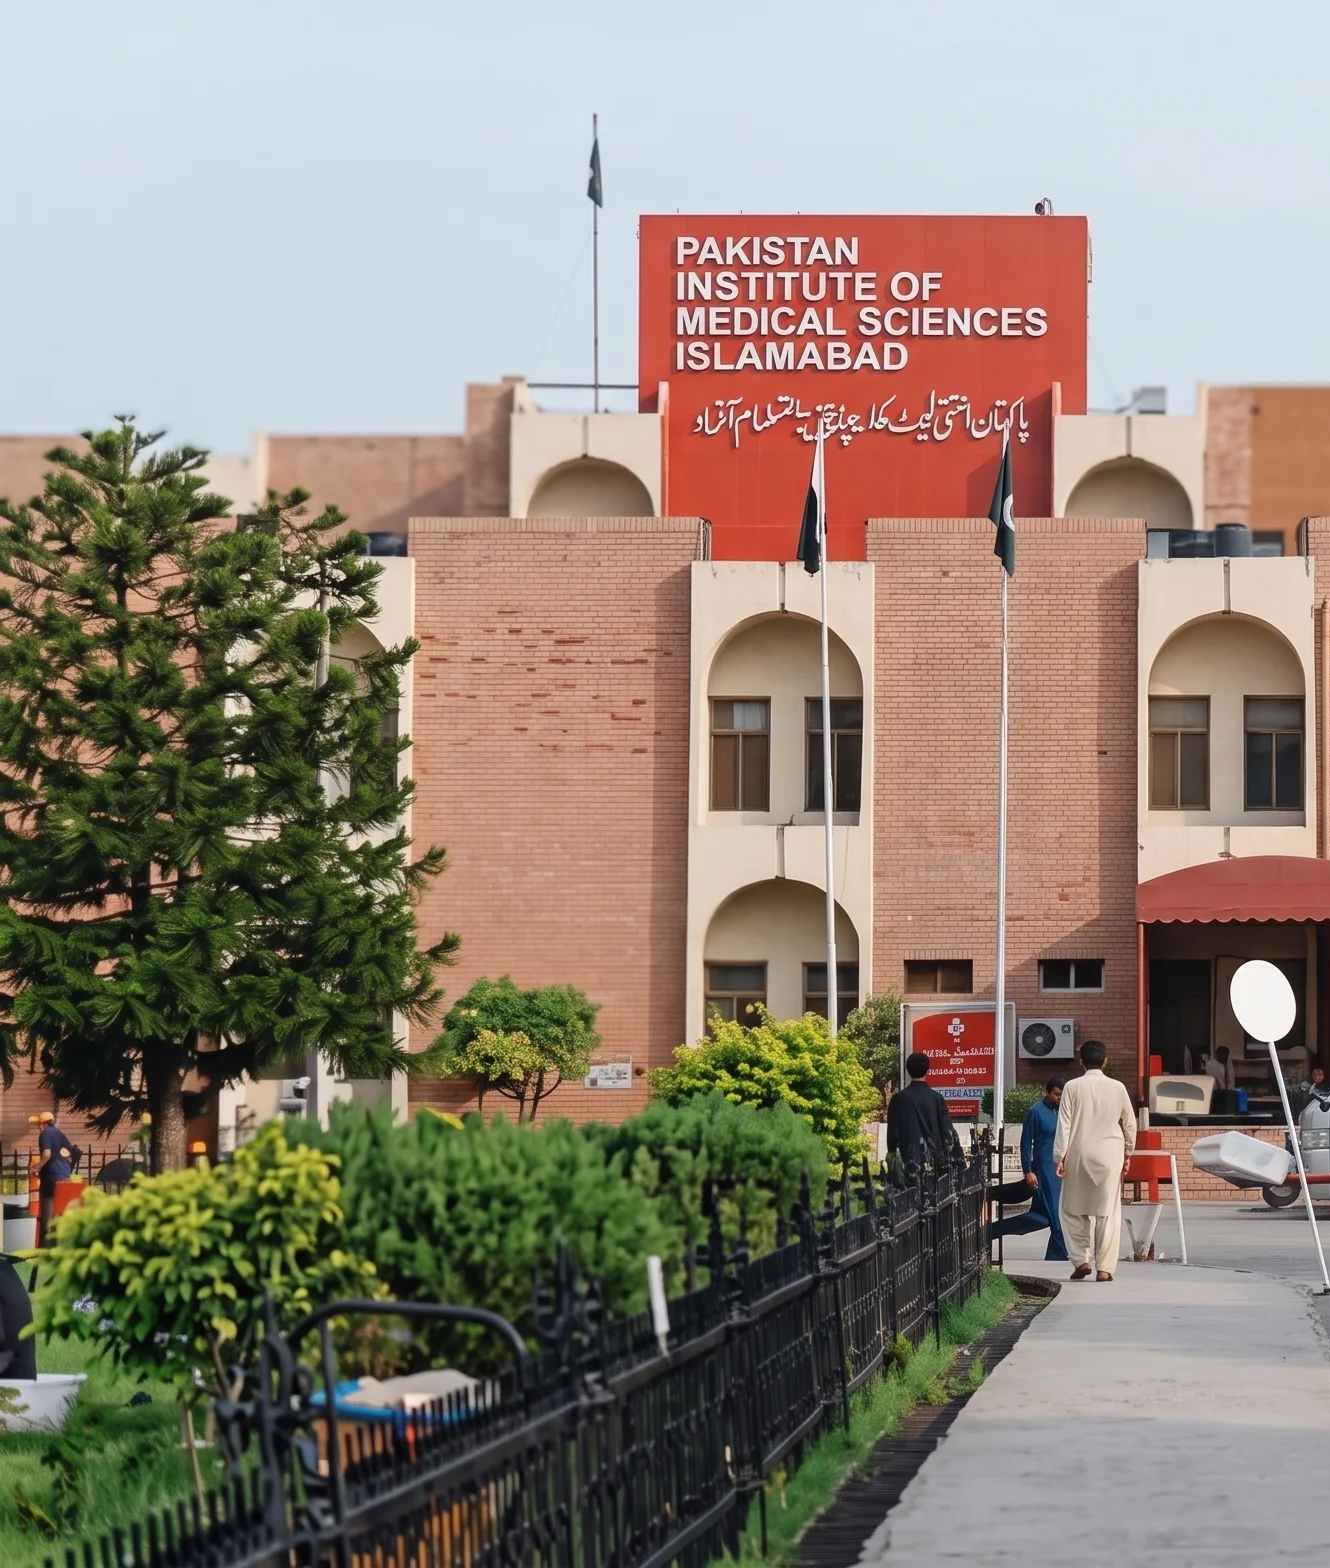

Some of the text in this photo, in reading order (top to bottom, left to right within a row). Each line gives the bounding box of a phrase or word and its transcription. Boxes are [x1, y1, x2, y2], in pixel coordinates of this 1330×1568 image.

[676, 236, 859, 266] PAKISTAN
[676, 271, 943, 301] INSTITUTE OF
[676, 306, 1048, 337] MEDICAL SCIENCES
[676, 341, 909, 371] ISLAMABAD
